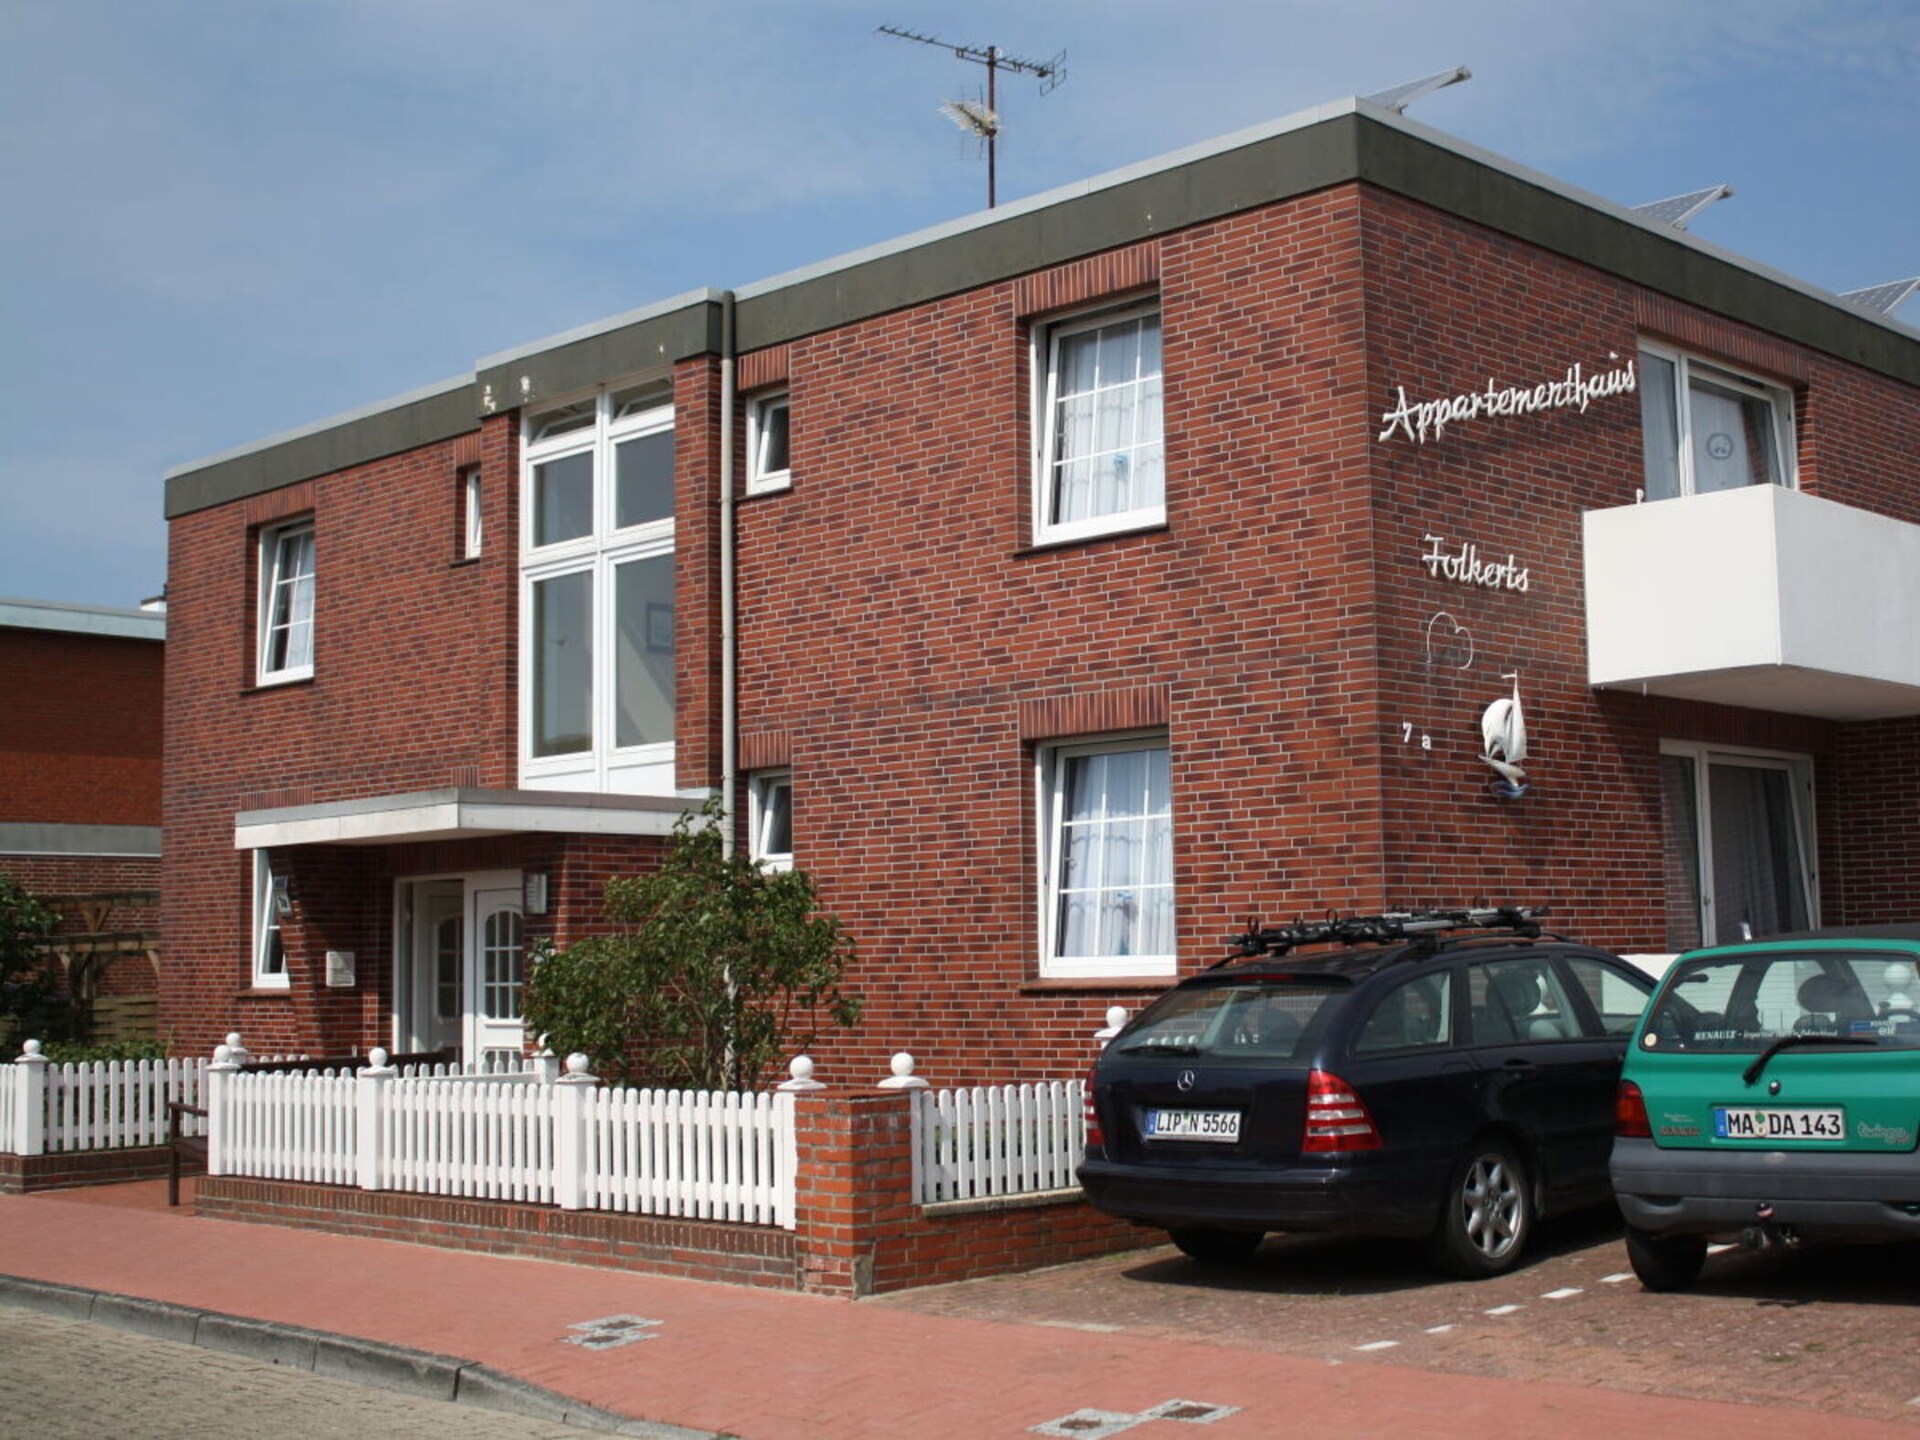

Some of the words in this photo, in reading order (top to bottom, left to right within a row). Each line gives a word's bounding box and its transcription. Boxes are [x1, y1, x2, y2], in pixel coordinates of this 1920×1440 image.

[1422, 533, 1530, 592] Folkerts
[1402, 721, 1413, 743] 7
[1421, 734, 1432, 750] a
[1156, 1112, 1182, 1132] LIP
[1189, 1114, 1200, 1133] N
[1202, 1114, 1238, 1134] 5566
[1727, 1112, 1755, 1134] MA
[1767, 1113, 1796, 1135] DA
[1799, 1113, 1841, 1136] 143
